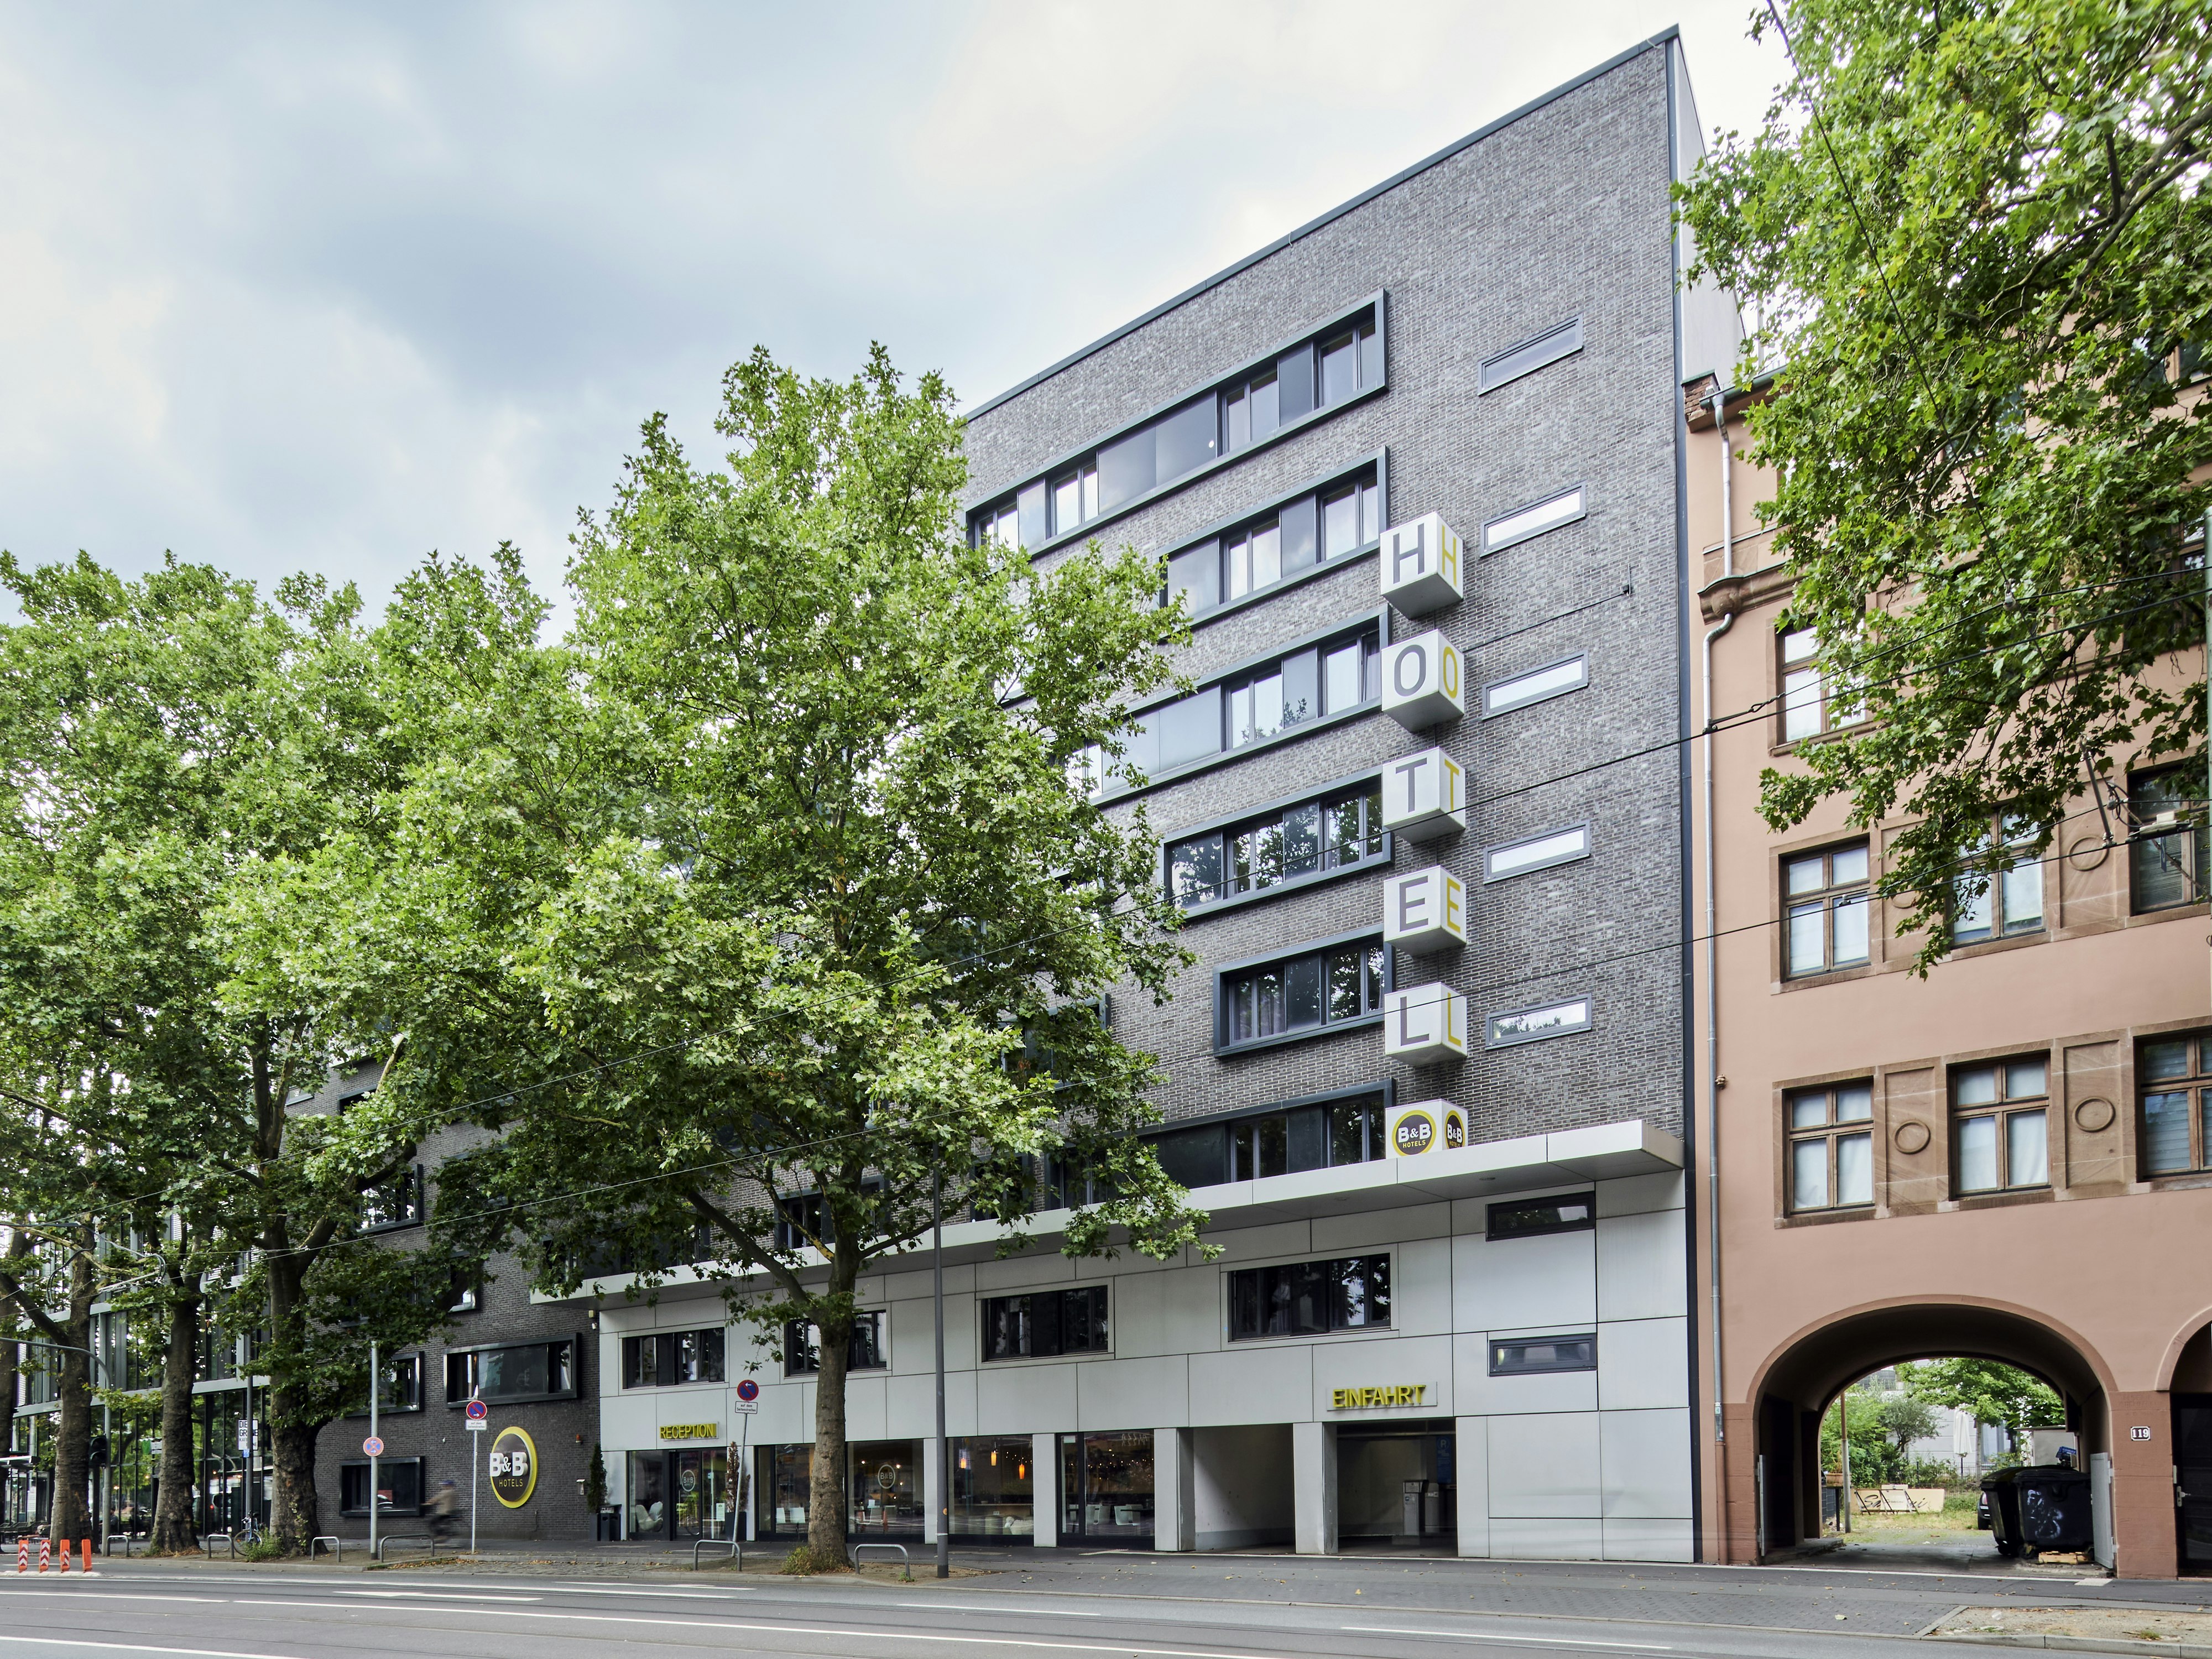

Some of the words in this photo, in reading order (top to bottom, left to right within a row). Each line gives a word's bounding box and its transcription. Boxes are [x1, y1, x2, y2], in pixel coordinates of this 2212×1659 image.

[1393, 523, 1430, 1046] HOTEL
[1441, 524, 1462, 1047] HOTEL
[1398, 1123, 1431, 1143] B&B
[1447, 1123, 1463, 1143] B&B
[1402, 1140, 1426, 1148] HOTELS
[1333, 1385, 1426, 1407] EINFAHRT
[660, 1423, 716, 1439] RECEPTION
[2132, 1428, 2149, 1438] 119
[490, 1452, 528, 1477] B&B
[499, 1479, 523, 1487] HOTELS
